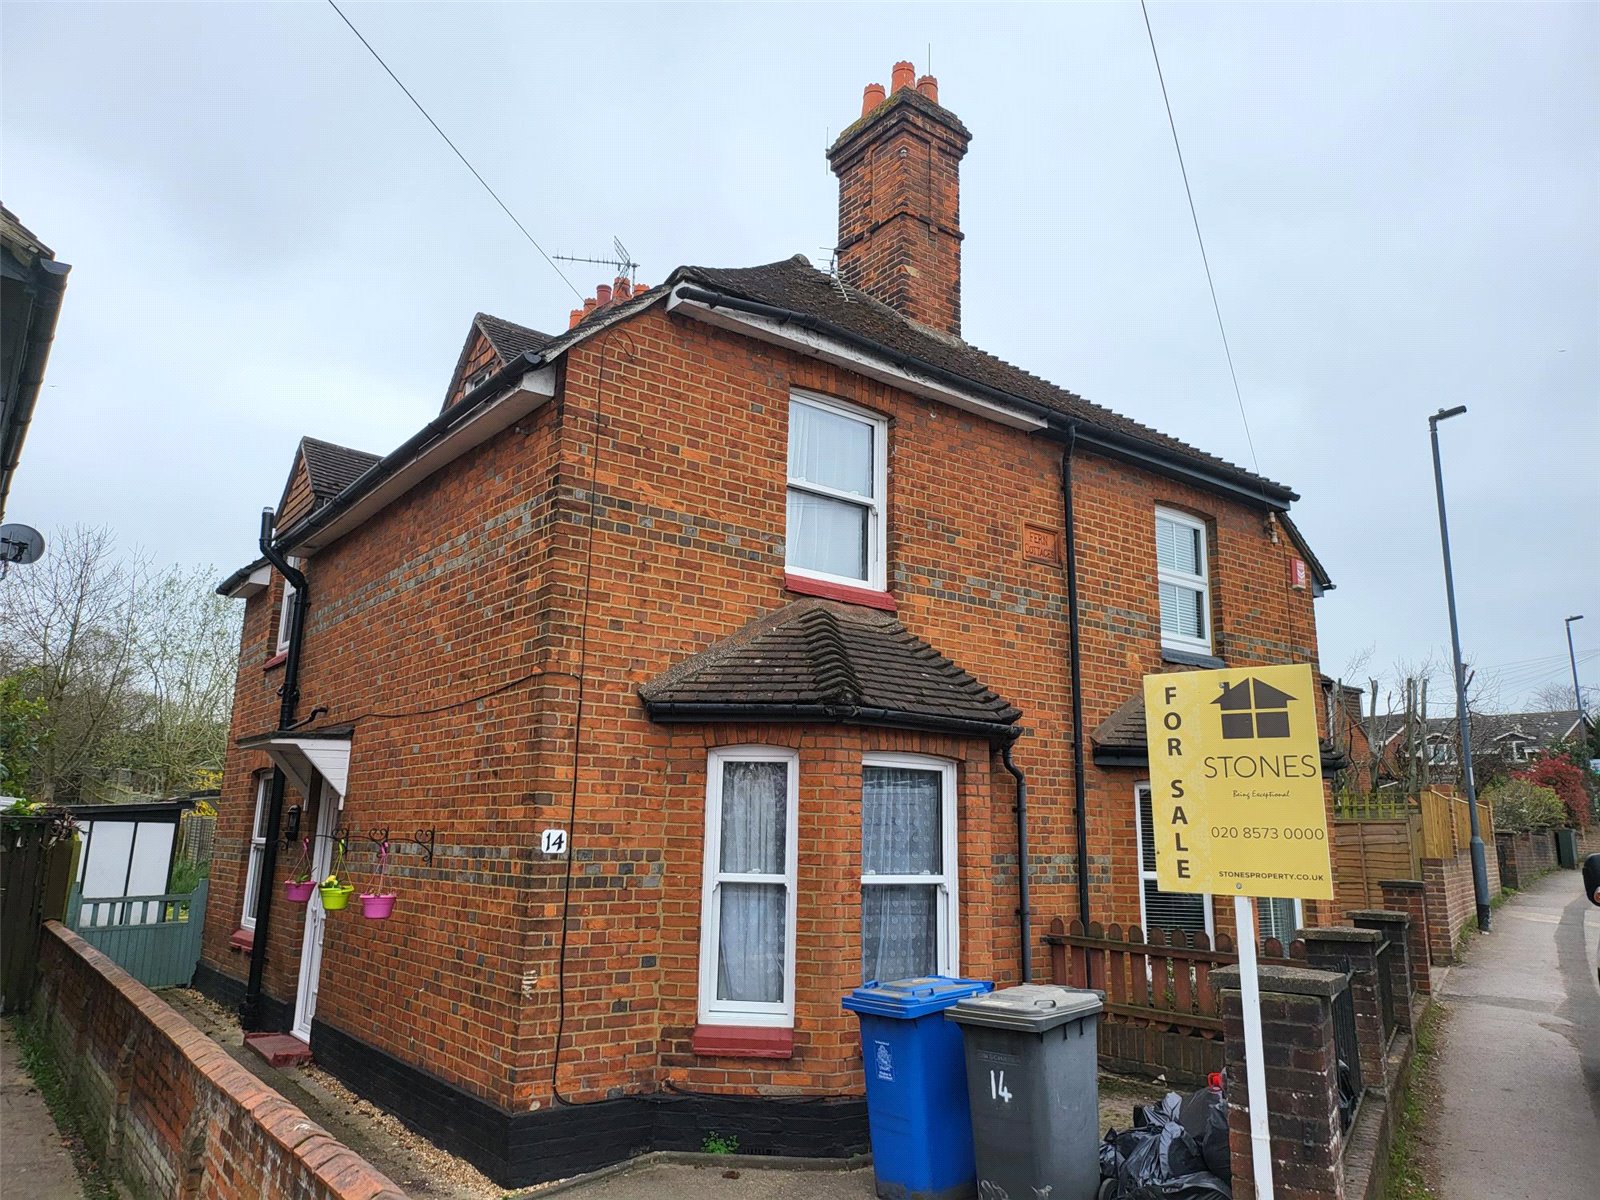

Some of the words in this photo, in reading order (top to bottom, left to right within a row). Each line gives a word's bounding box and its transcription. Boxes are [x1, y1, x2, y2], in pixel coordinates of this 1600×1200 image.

[1164, 686, 1182, 756] FOR
[1204, 754, 1317, 779] STONES
[1232, 789, 1251, 799] Being
[1251, 789, 1290, 799] Exceptional
[1170, 779, 1191, 879] SALE
[1211, 826, 1239, 839] 020
[1242, 827, 1279, 840] 8573
[1283, 828, 1325, 841] 0000
[545, 832, 565, 852] 14
[1219, 870, 1325, 881] STONESPROPERTY.CO.UK
[990, 1070, 1013, 1103] 14
